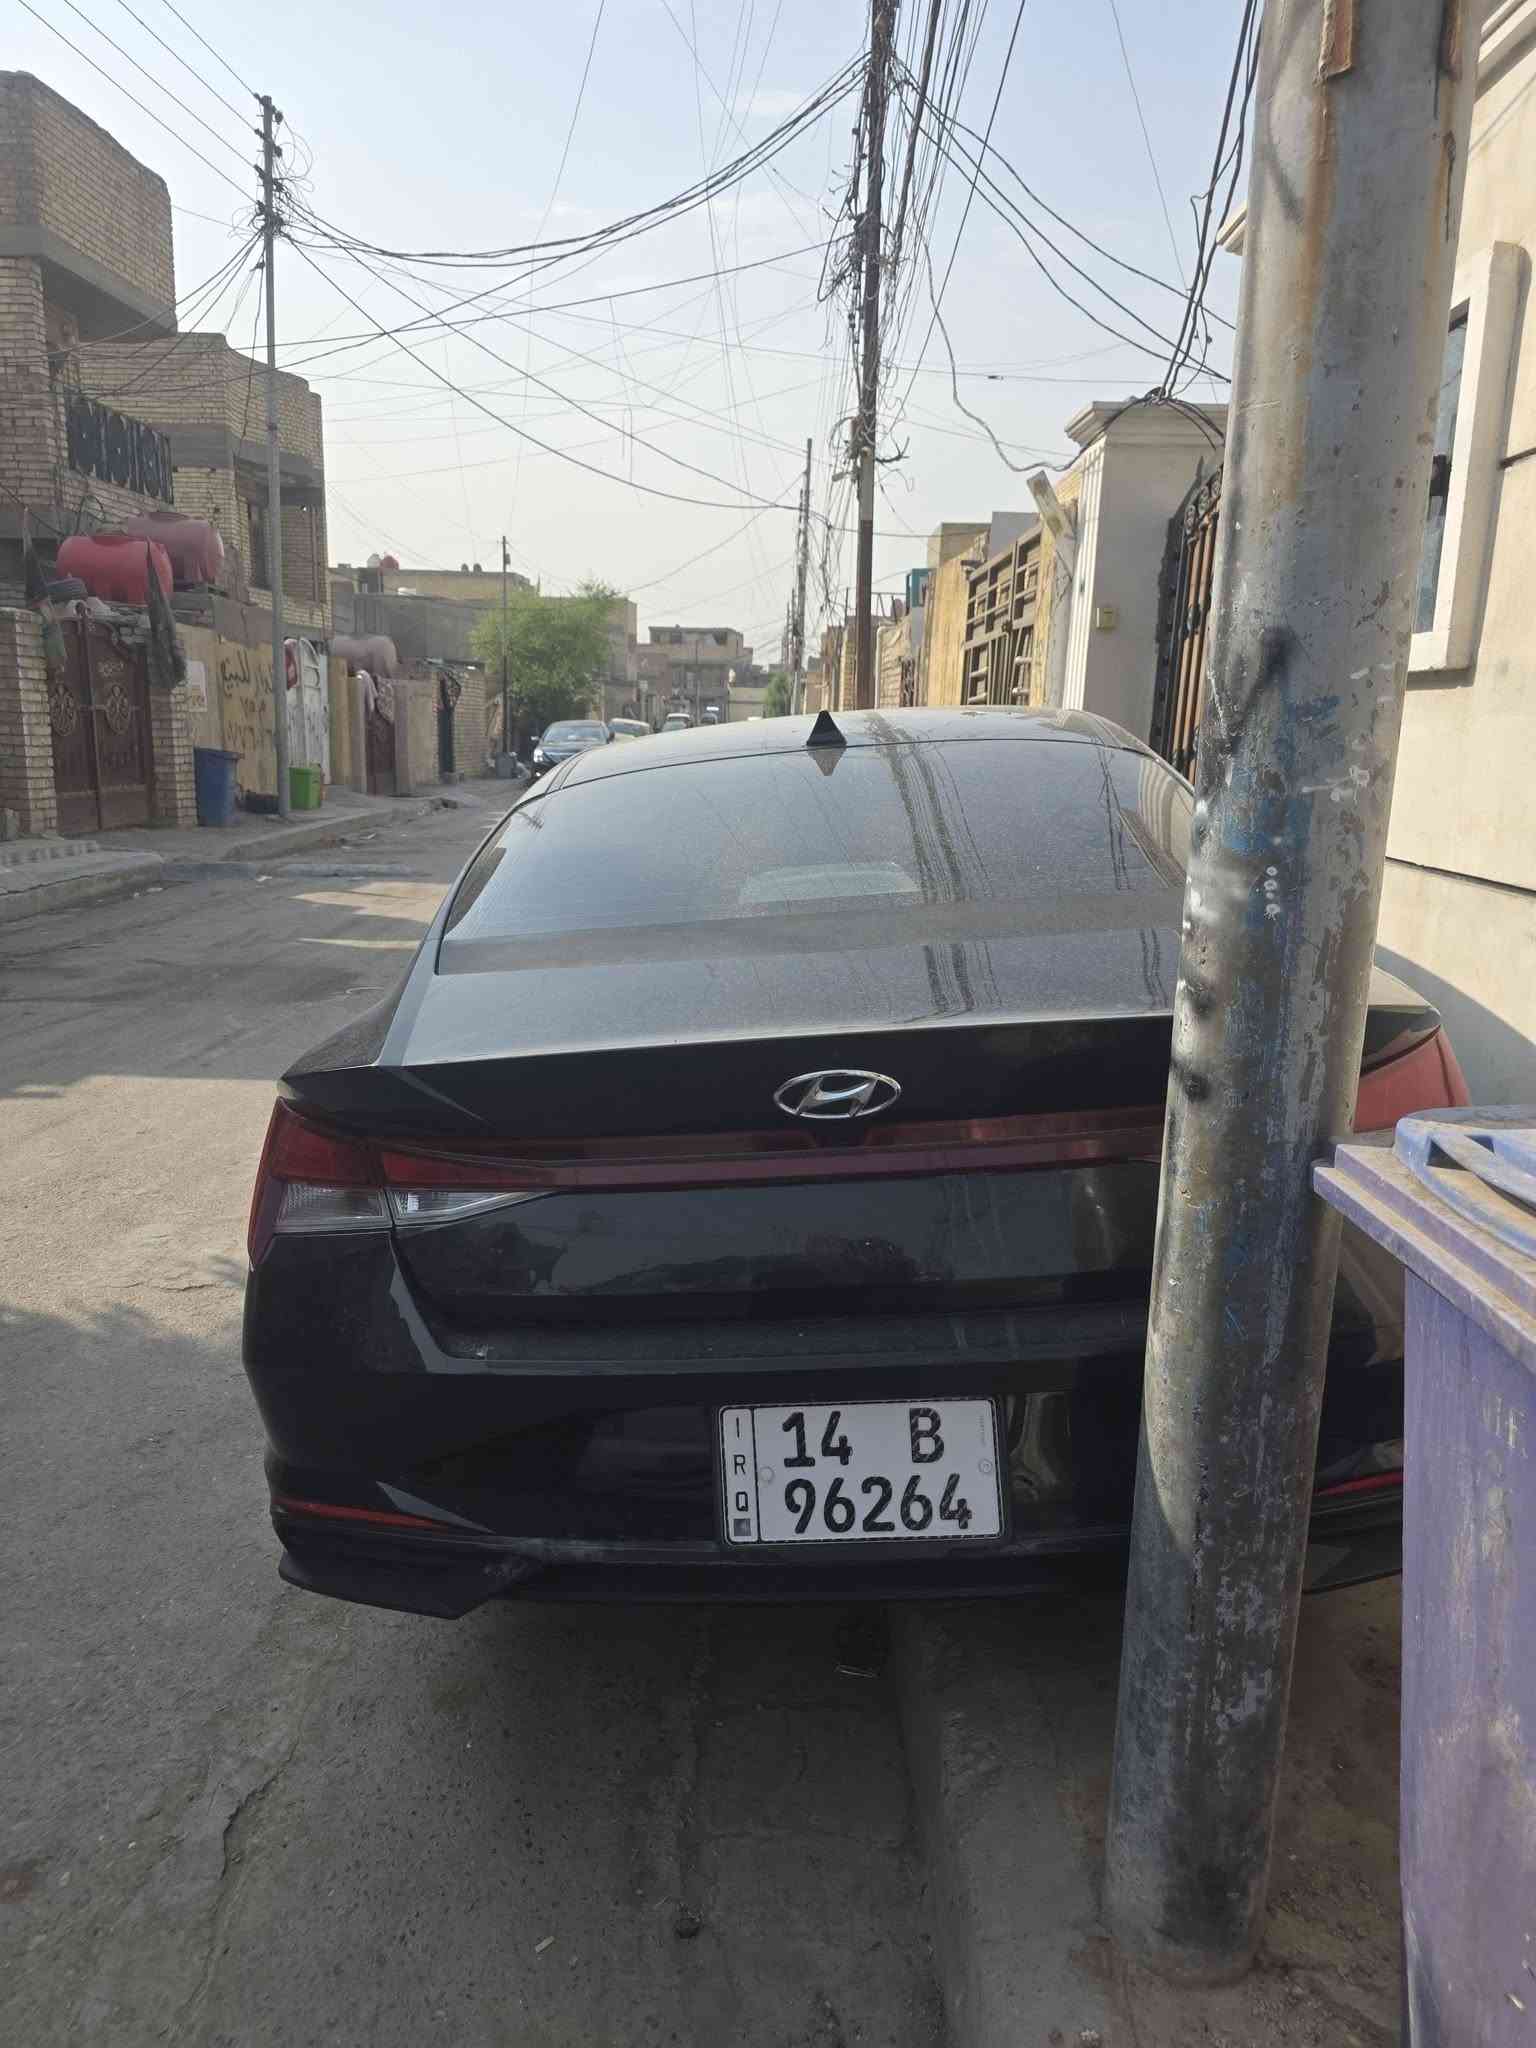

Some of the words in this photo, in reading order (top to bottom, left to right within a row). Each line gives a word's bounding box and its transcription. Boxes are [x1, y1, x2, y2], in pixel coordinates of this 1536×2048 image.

[782, 1411, 853, 1467] 14
[909, 1407, 945, 1463] B
[784, 1473, 972, 1534] 96264
